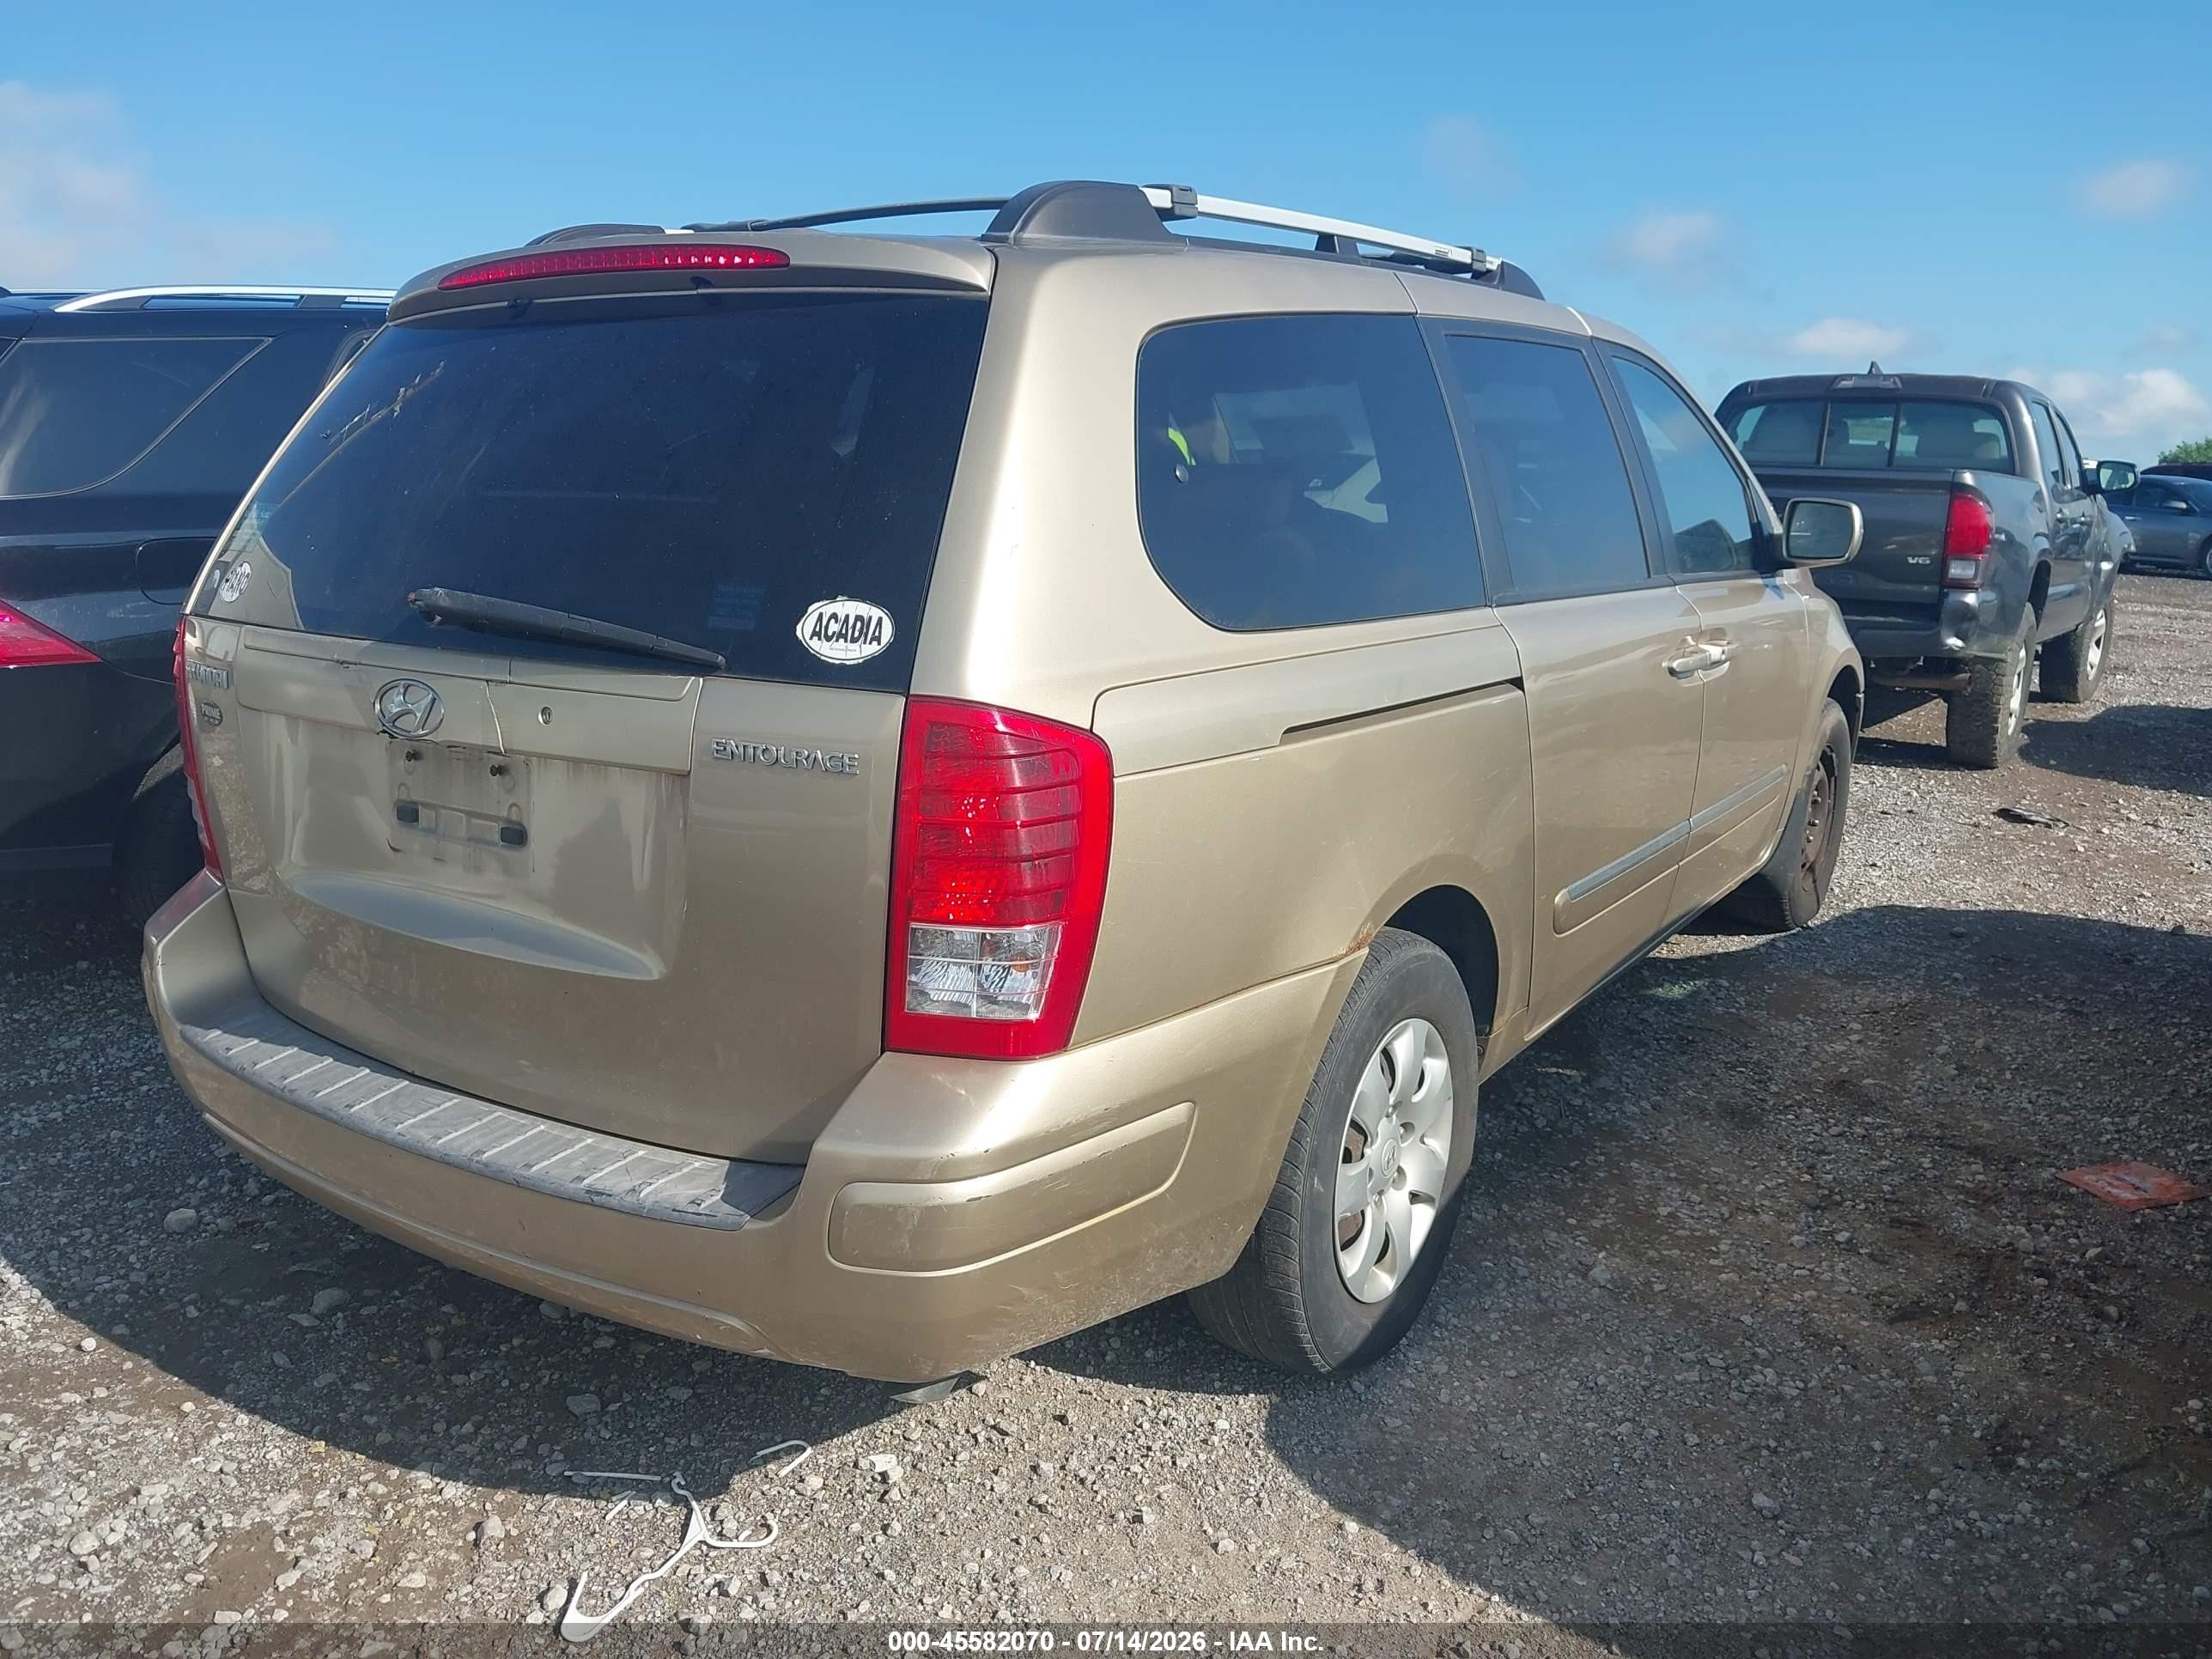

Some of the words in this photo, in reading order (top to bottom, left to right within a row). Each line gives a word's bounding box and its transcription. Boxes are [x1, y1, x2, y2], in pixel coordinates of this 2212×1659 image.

[1906, 556, 1931, 565] V6
[809, 611, 884, 647] ACADIA
[713, 738, 860, 775] ENTOURAGE
